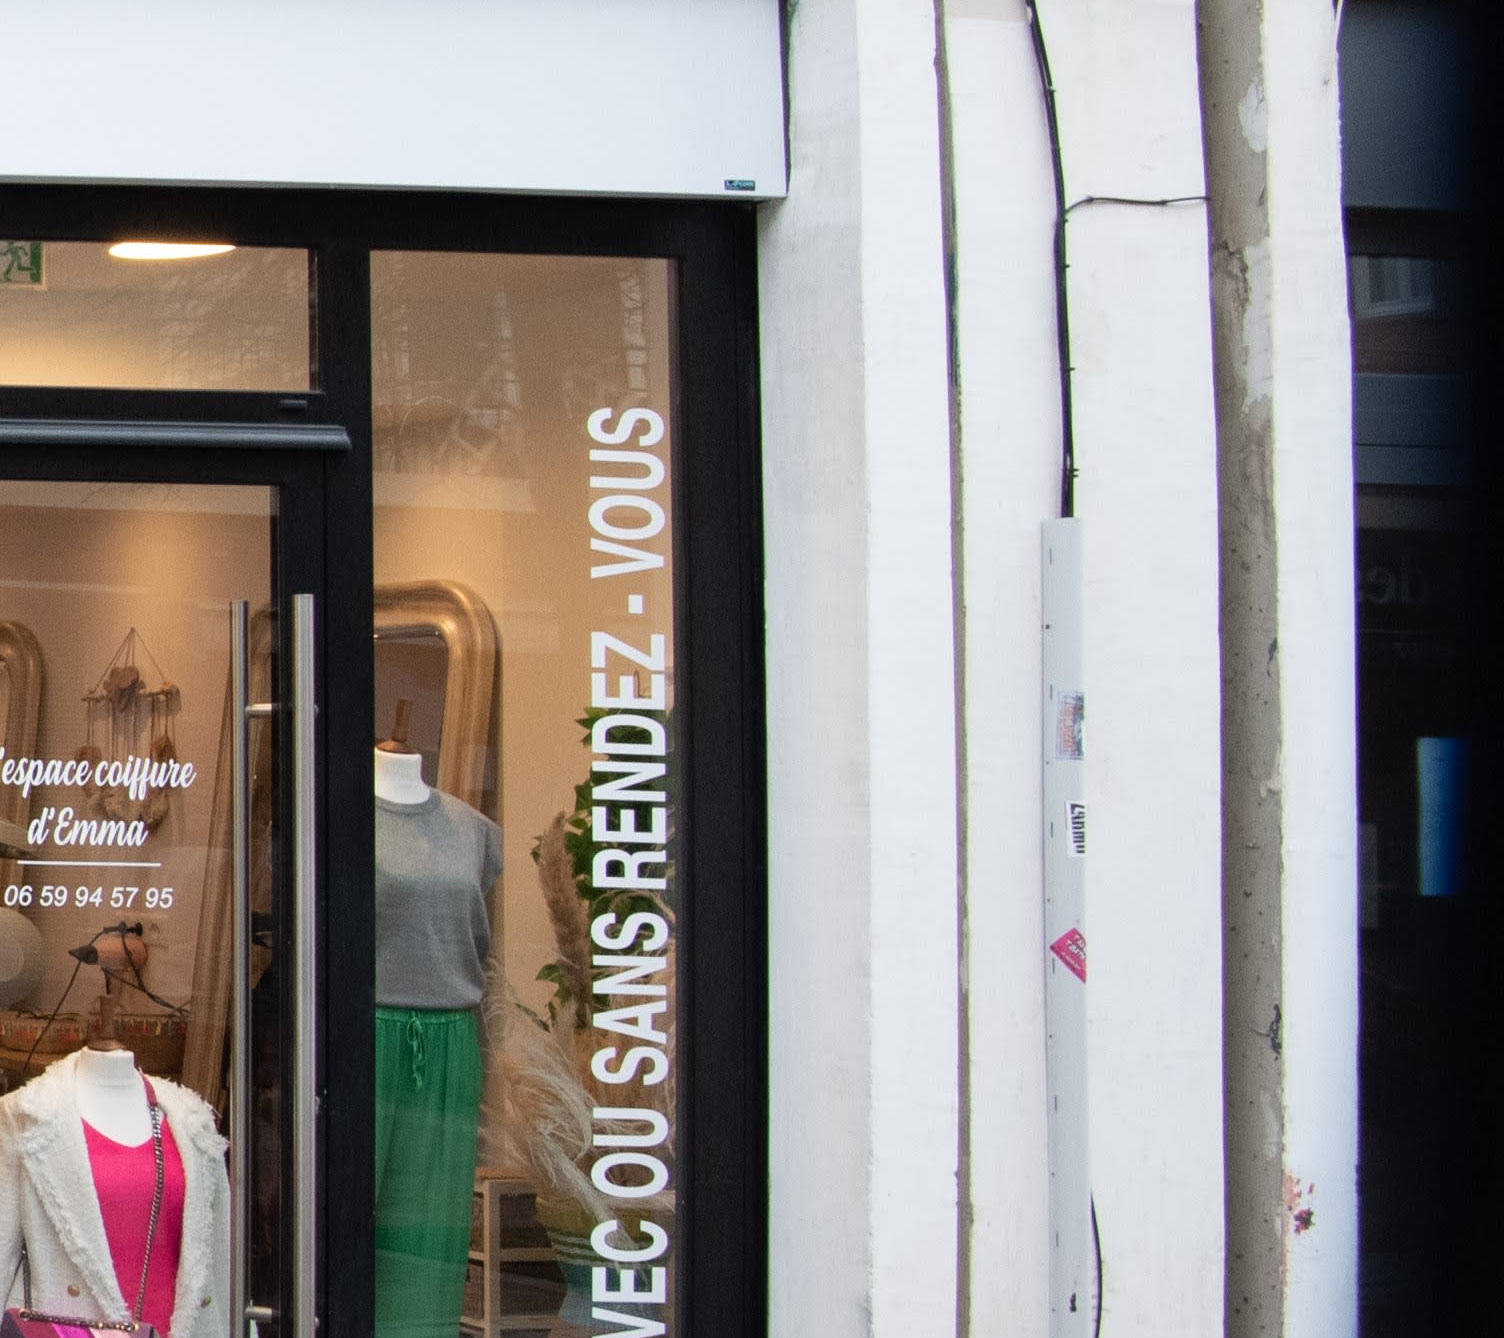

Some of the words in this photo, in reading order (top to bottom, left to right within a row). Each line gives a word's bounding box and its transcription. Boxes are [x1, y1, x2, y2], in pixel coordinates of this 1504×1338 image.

[588, 408, 666, 578] VOUS
[95, 756, 196, 800] coiffure
[591, 632, 668, 889] RENDEZ
[28, 807, 148, 846] d'Emma
[5, 885, 32, 905] 06
[40, 886, 67, 906] 59
[76, 887, 102, 907] 94
[111, 887, 138, 907] 57
[146, 888, 173, 908] 95
[591, 913, 668, 1085] SANS
[591, 1107, 668, 1198] OU
